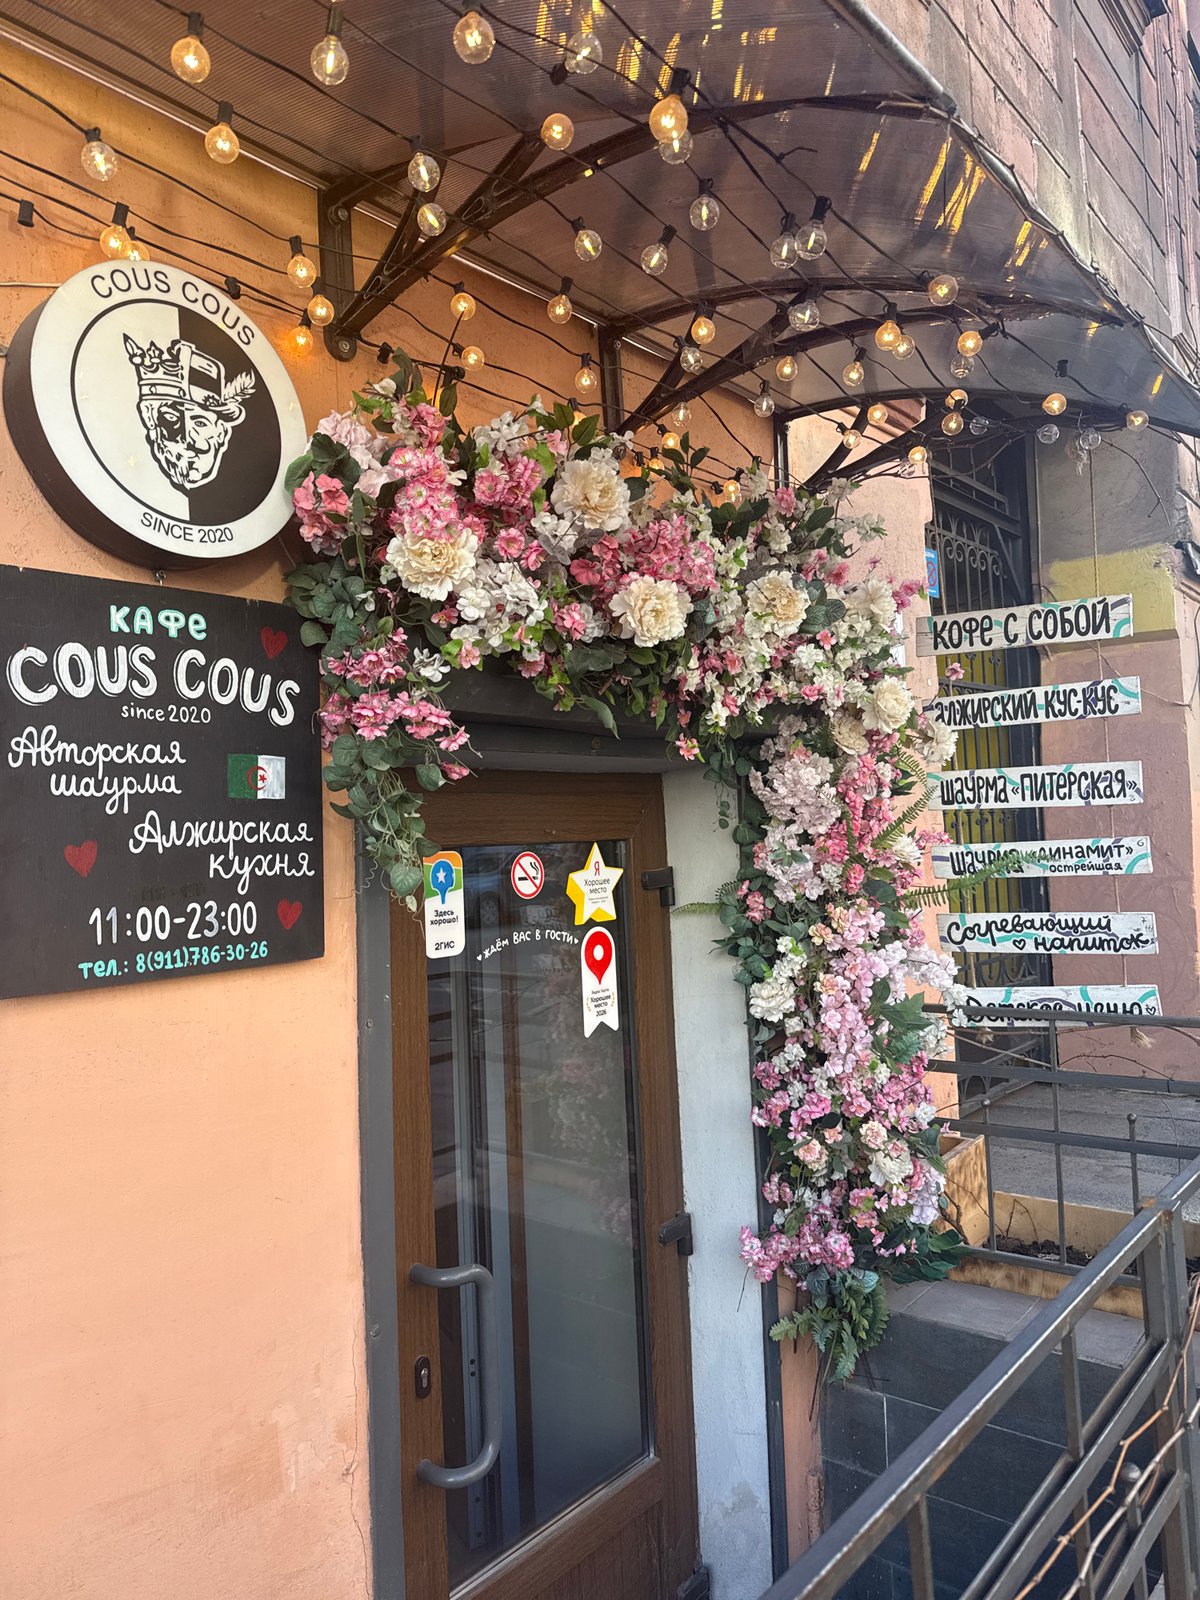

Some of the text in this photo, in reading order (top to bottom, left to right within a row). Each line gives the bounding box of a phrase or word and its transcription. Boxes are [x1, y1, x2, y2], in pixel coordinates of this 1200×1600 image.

[91, 267, 255, 346] COUS COUS
[140, 511, 234, 544] SINCE 2020
[1003, 612, 1018, 644] С
[1028, 597, 1111, 640] СОБОЙ
[6, 641, 300, 727] COUS COUS
[121, 704, 211, 723] since 2020
[8, 724, 186, 779] Авторская
[50, 771, 181, 814] шаурма
[129, 810, 314, 859] Алжирская
[209, 852, 315, 894] кухня
[593, 860, 601, 876] Я
[1049, 860, 1123, 874] острейшая
[583, 878, 611, 888] Хорошее
[589, 886, 608, 895] место
[88, 900, 257, 945] 11:00-23:00
[429, 915, 459, 926] хорошо!
[434, 909, 455, 917] Здесь
[512, 931, 532, 945] ВАС
[535, 928, 541, 941] В
[545, 929, 573, 945] ГОСТИ
[947, 914, 1112, 946] Согревающий
[1035, 931, 1150, 953] напиток
[434, 940, 455, 951] 2ГИС
